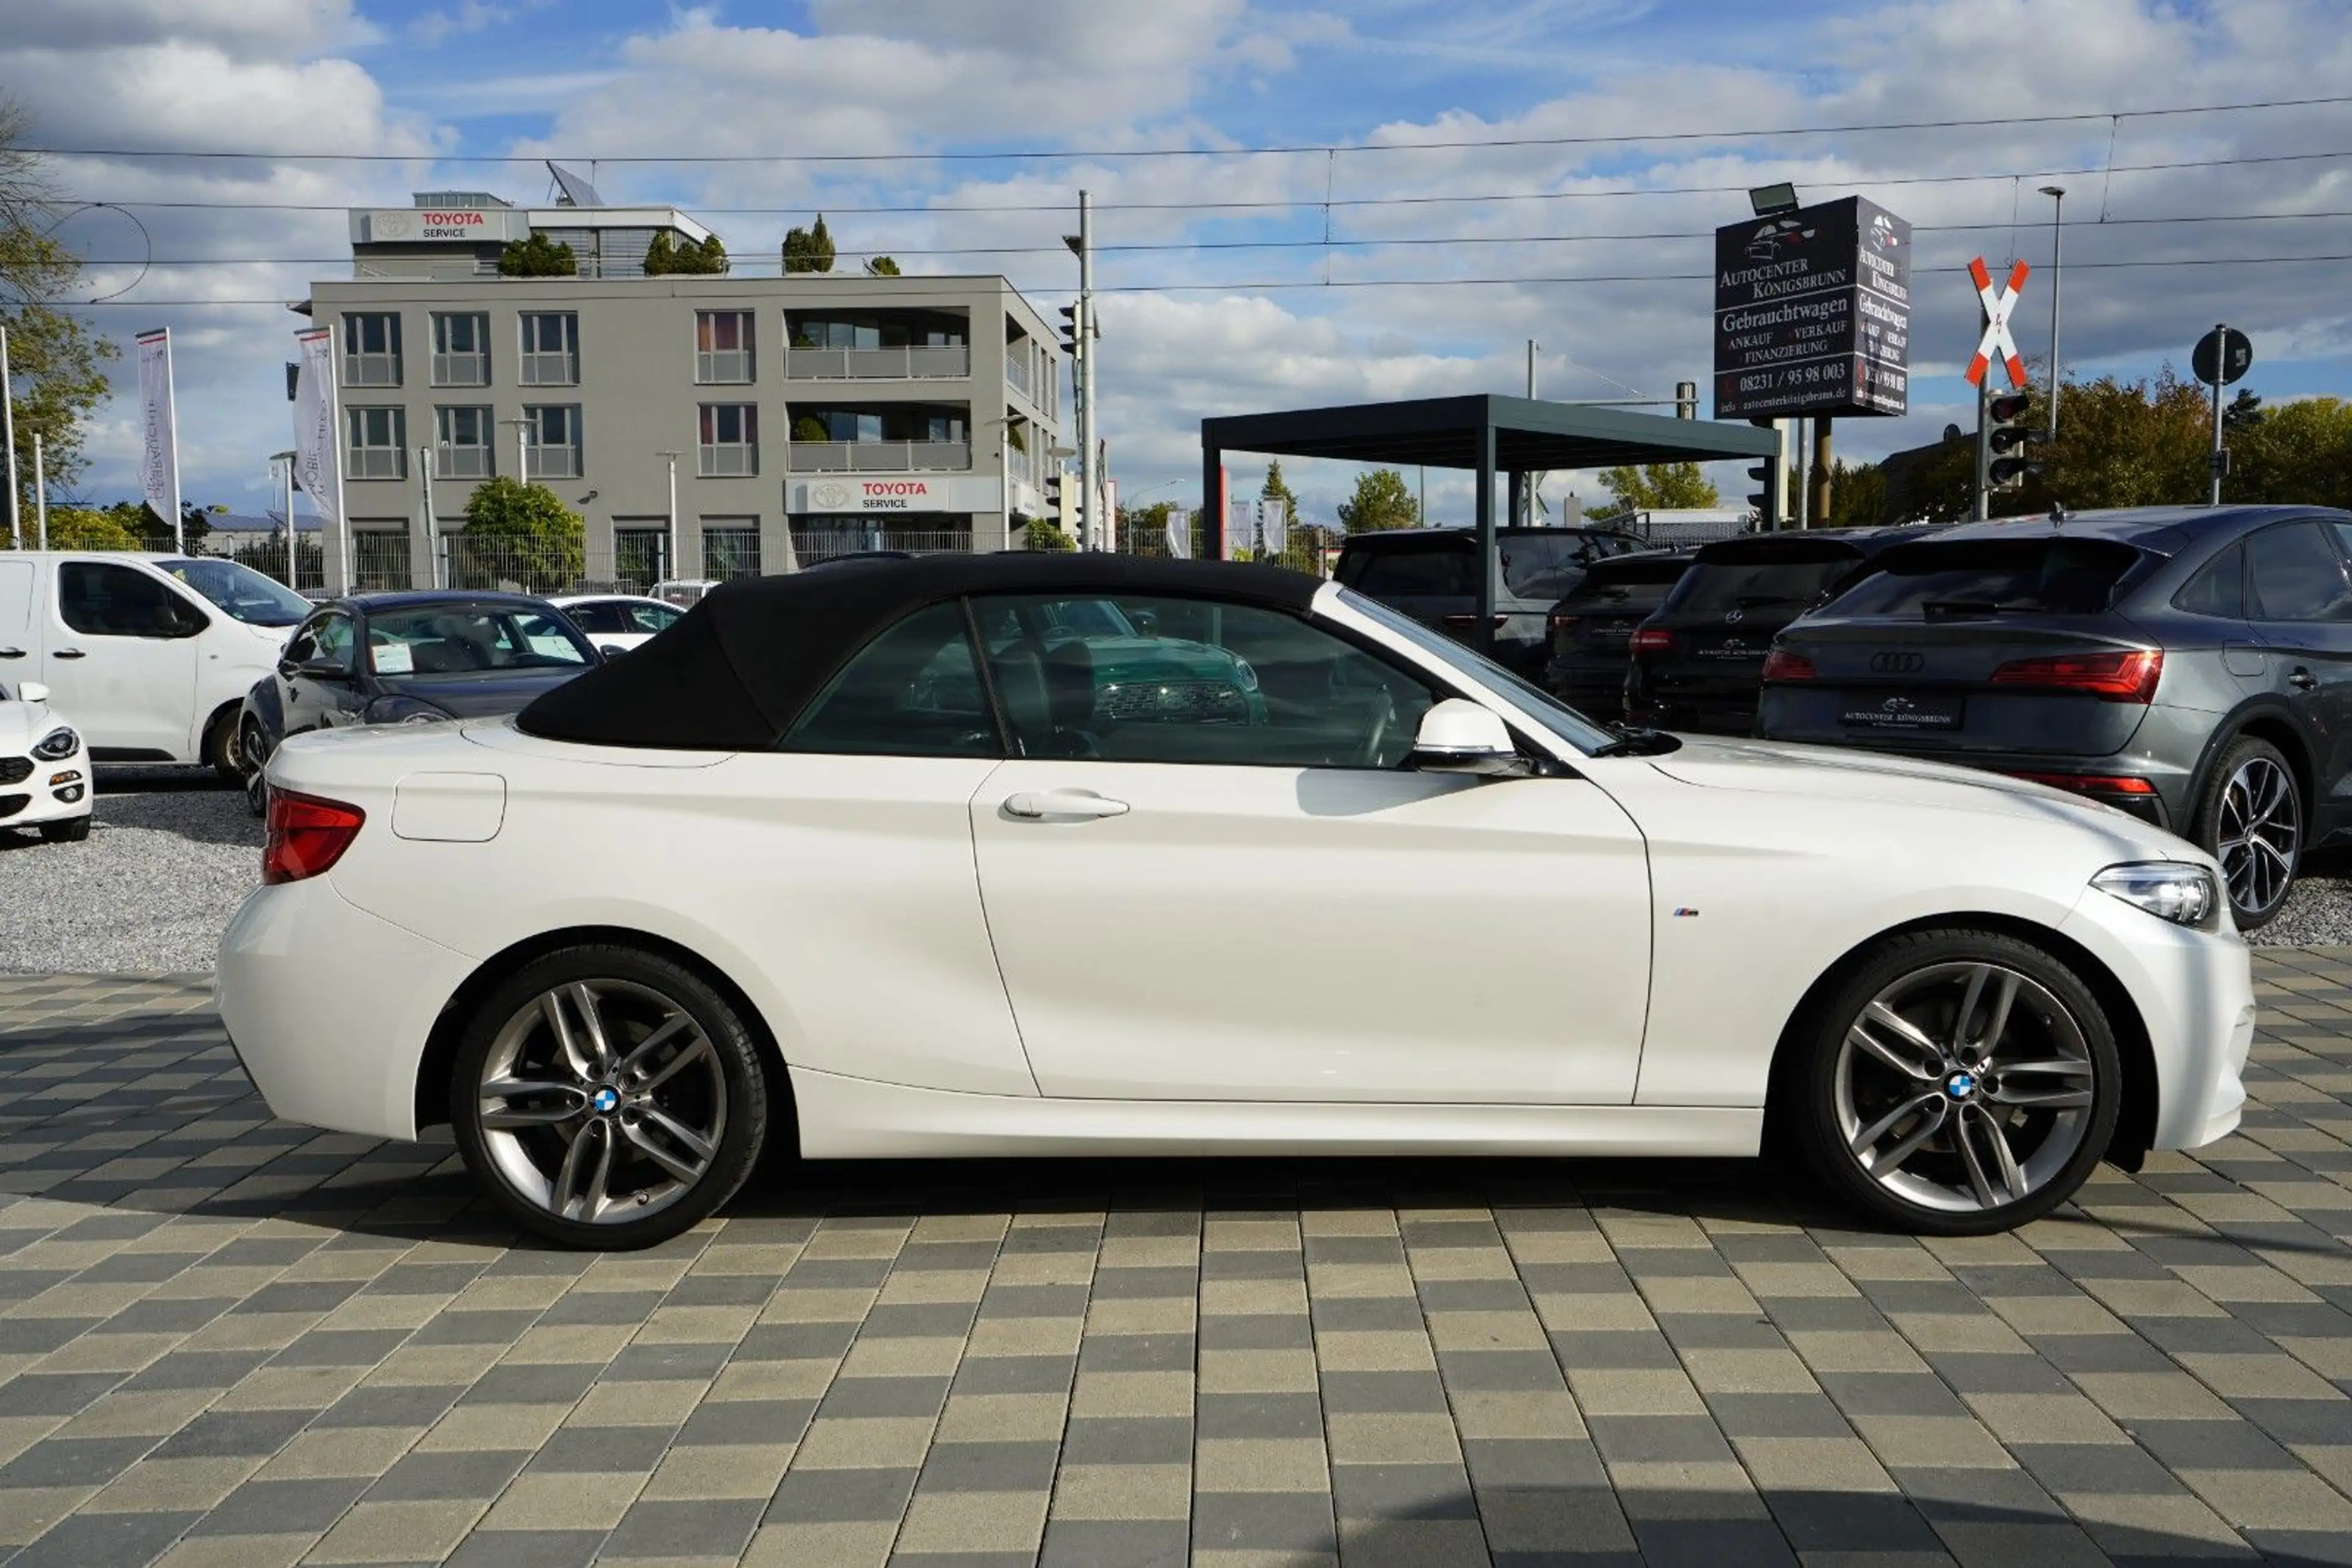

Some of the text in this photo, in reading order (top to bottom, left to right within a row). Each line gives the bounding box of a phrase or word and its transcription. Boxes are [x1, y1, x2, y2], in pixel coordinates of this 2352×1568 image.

[423, 213, 483, 225] TOYOTA
[423, 228, 466, 238] SERVICE
[1720, 258, 1808, 288] AUTOCENTER
[1722, 298, 1847, 331] Gebrauchtwagen
[1729, 333, 1774, 350] ANKAUF
[1795, 320, 1847, 339] VERKAUF
[1745, 340, 1828, 364] FINANZIERUNG
[1740, 374, 1772, 392] 08231
[1787, 369, 1802, 385] 95
[1806, 366, 1820, 382] 98
[1823, 362, 1845, 380] 003
[862, 483, 927, 495] TOYOTA
[863, 499, 907, 508] SERVICE
